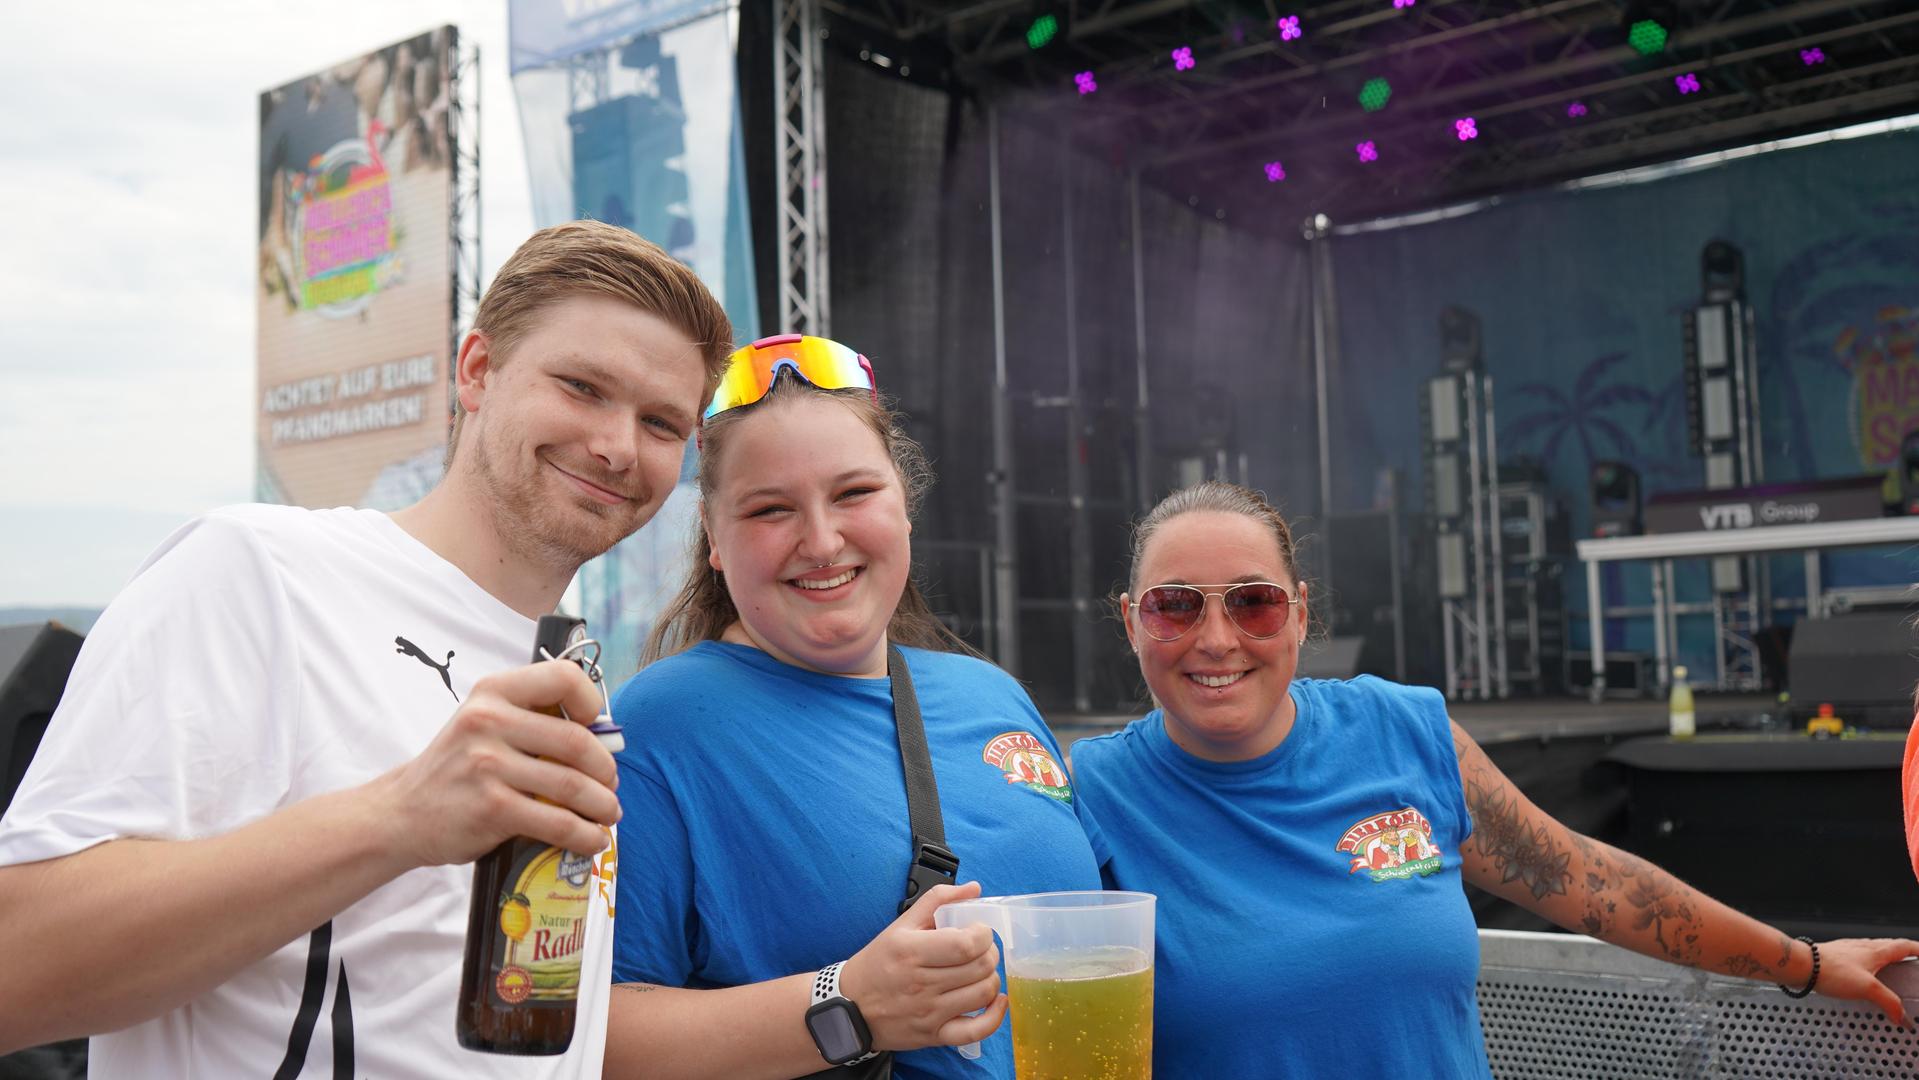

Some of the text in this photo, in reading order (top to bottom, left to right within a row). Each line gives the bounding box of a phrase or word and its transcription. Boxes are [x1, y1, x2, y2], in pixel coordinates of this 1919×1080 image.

[265, 376, 336, 412] ACHTET
[337, 366, 376, 398] AUF
[1701, 501, 1820, 529] VTB Group
[538, 914, 570, 928] Natur
